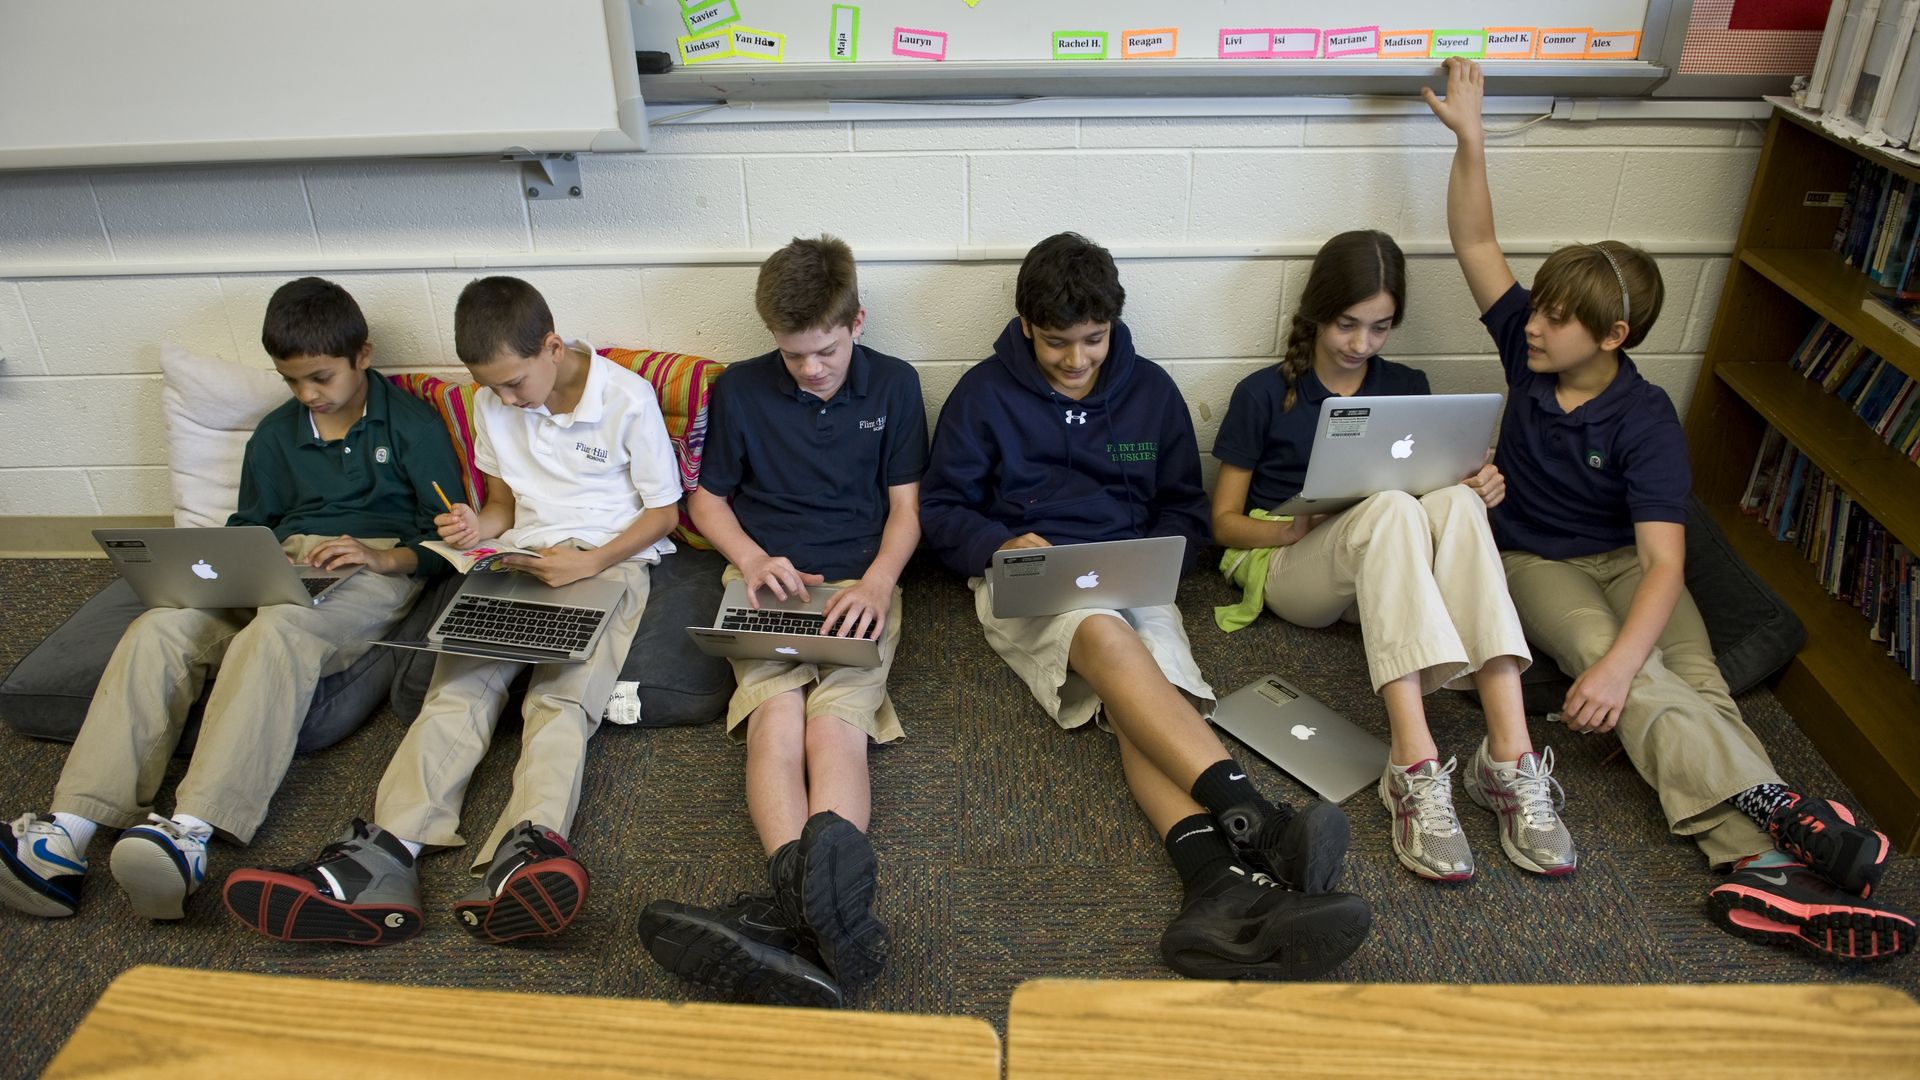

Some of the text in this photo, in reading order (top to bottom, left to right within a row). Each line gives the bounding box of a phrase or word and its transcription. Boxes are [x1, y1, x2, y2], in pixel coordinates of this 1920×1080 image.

[690, 9, 718, 25] Xavier
[735, 33, 752, 44] Yan
[899, 34, 932, 46] Lauryn
[1058, 39, 1101, 48] Rachel H.
[1128, 37, 1162, 47] Reagan
[1225, 36, 1242, 45] Livi
[1329, 35, 1368, 46] Mariane
[1384, 37, 1422, 47] Madison
[1436, 38, 1469, 48] Sayeed
[1488, 34, 1529, 43] Rachel K.
[1543, 36, 1576, 44] Connor
[1591, 39, 1611, 47] Alex
[685, 40, 720, 54] Lindsay
[837, 33, 847, 56] Maja
